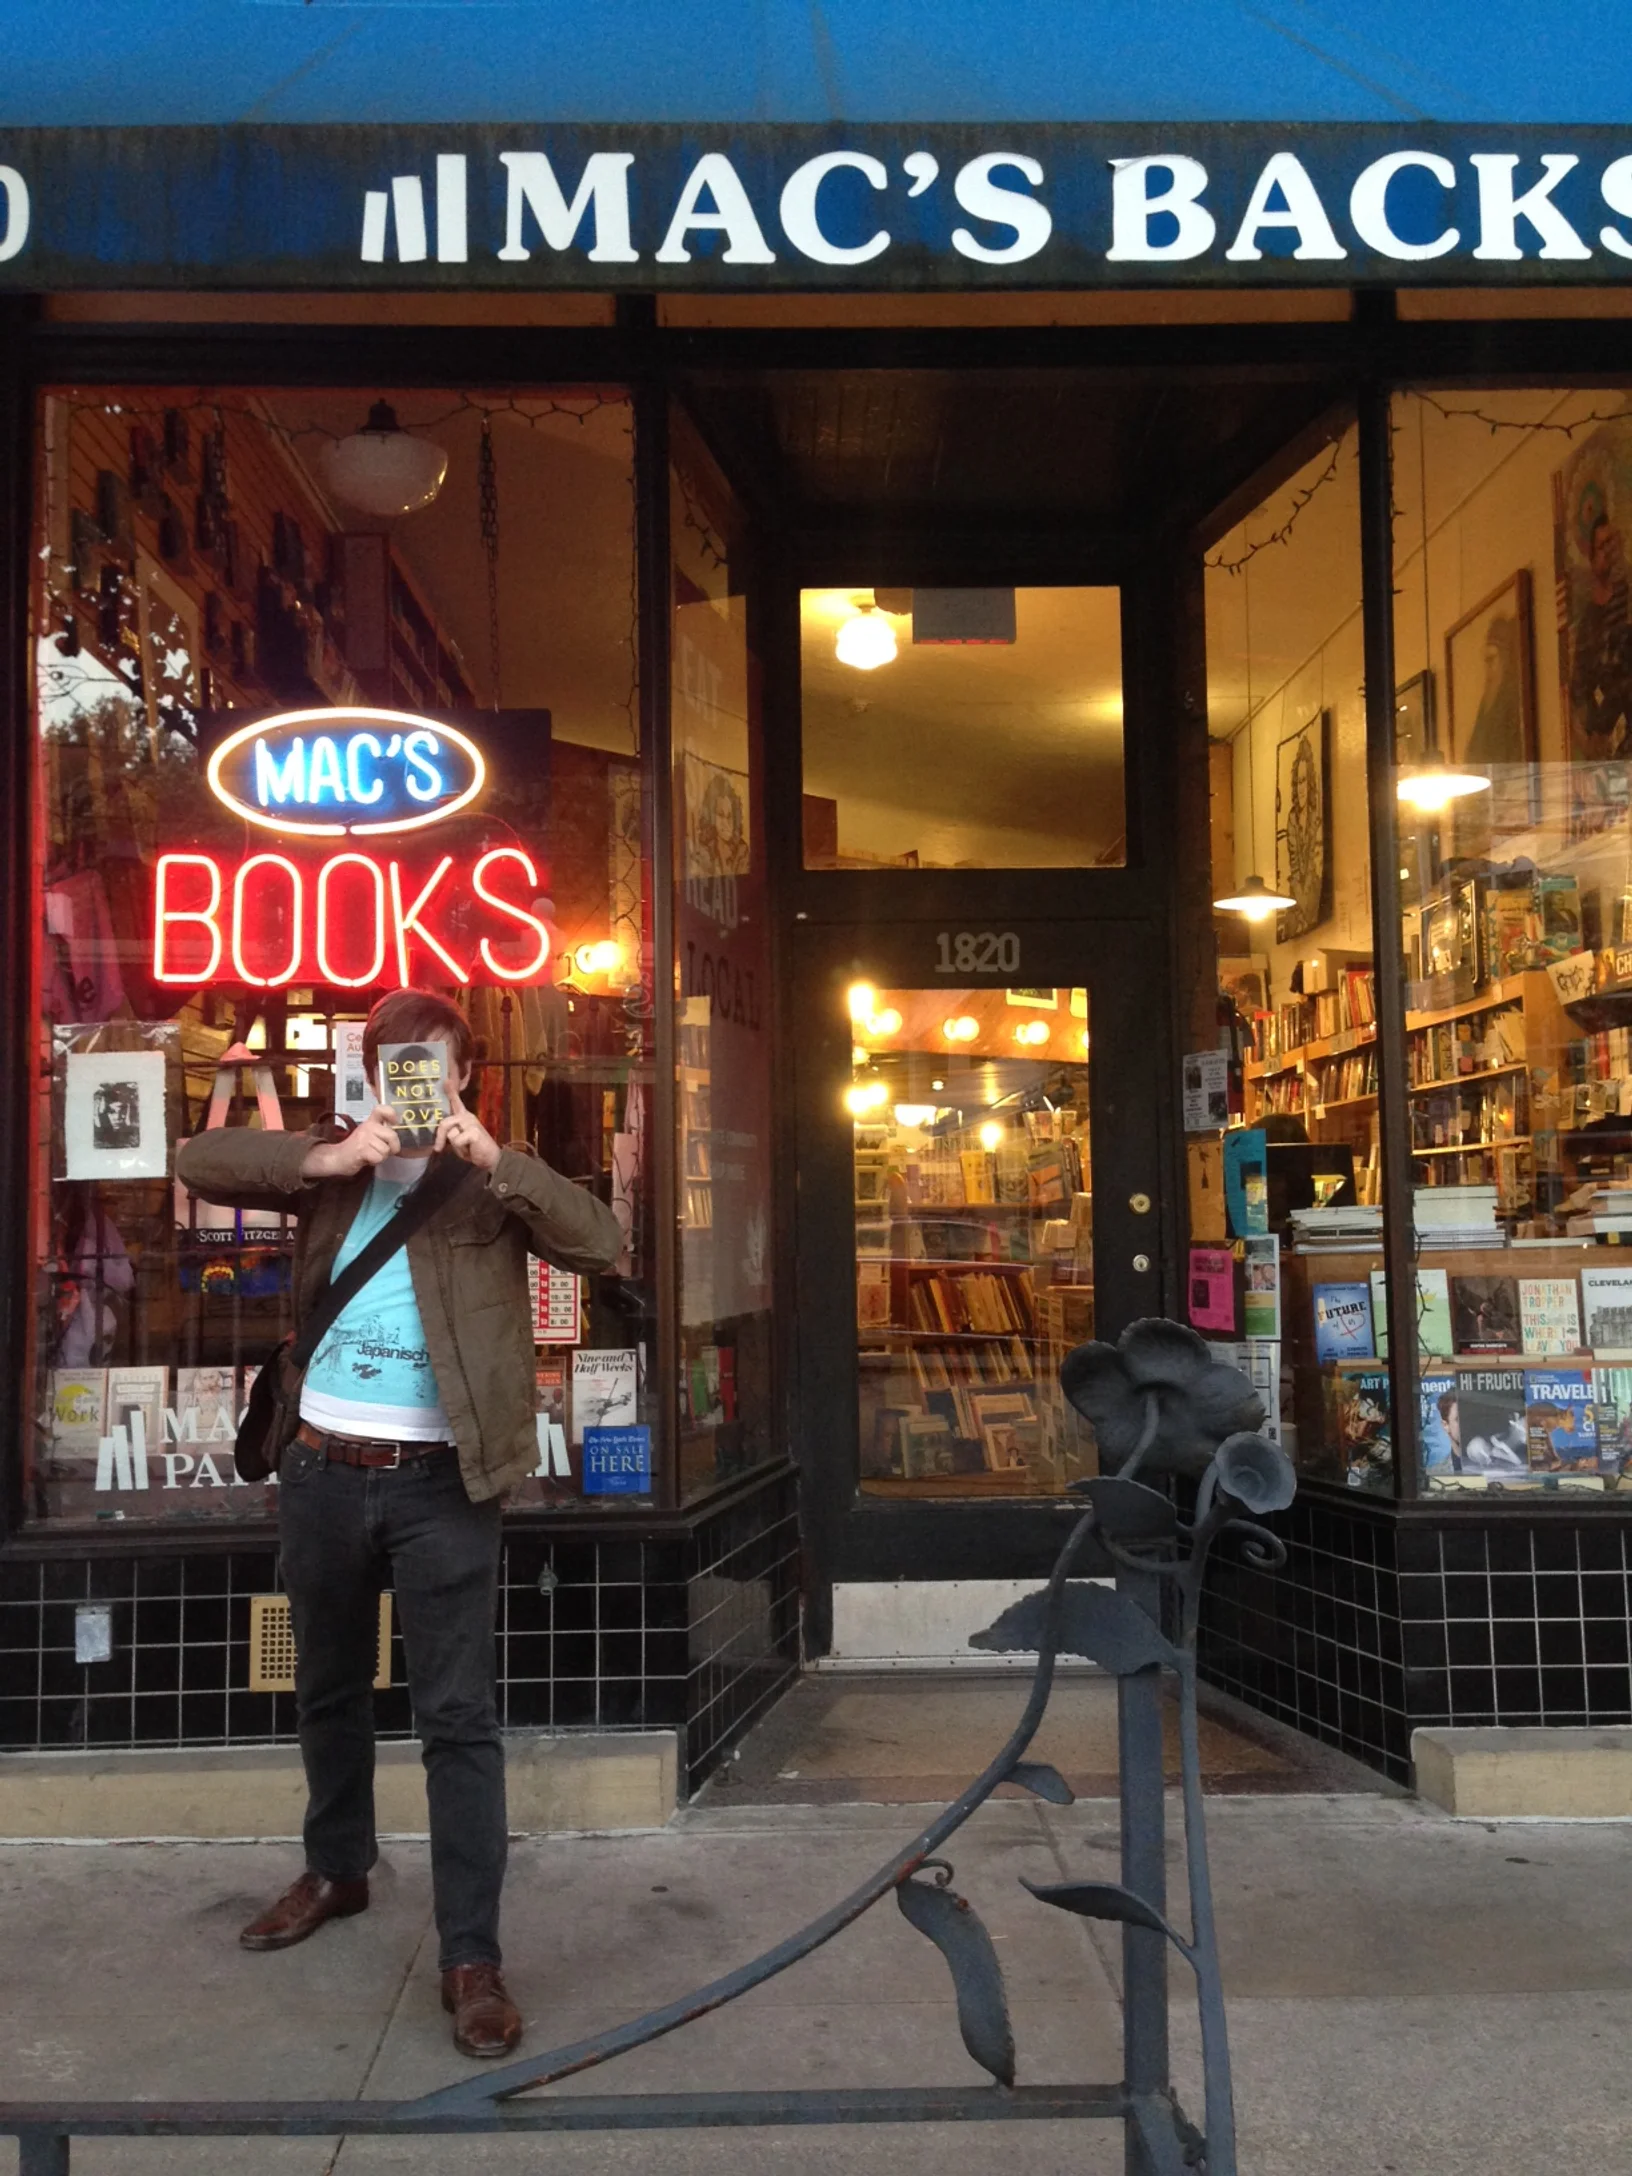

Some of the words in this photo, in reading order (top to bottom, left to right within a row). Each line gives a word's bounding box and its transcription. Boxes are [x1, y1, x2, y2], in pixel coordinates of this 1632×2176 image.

[498, 150, 1053, 265] MAC'S
[255, 730, 442, 806] MAC'S
[153, 848, 550, 987] BOOKS
[934, 931, 1020, 973] 1820
[387, 1059, 441, 1074] DOES
[396, 1084, 436, 1098] NOT
[402, 1107, 443, 1121] OVE
[199, 1230, 233, 1243] SCOTT
[1318, 1302, 1367, 1321] FUTURE
[1523, 1313, 1547, 1326] THIS
[356, 1340, 430, 1361] Japanisch
[577, 1353, 599, 1363] Nine
[601, 1352, 625, 1363] and
[574, 1363, 600, 1375] Half
[601, 1362, 633, 1373] Weeks
[1360, 1378, 1379, 1390] ART
[158, 1405, 249, 1444] MA
[590, 1445, 609, 1455] ON
[616, 1444, 644, 1455] SALE
[591, 1454, 645, 1472] HERE
